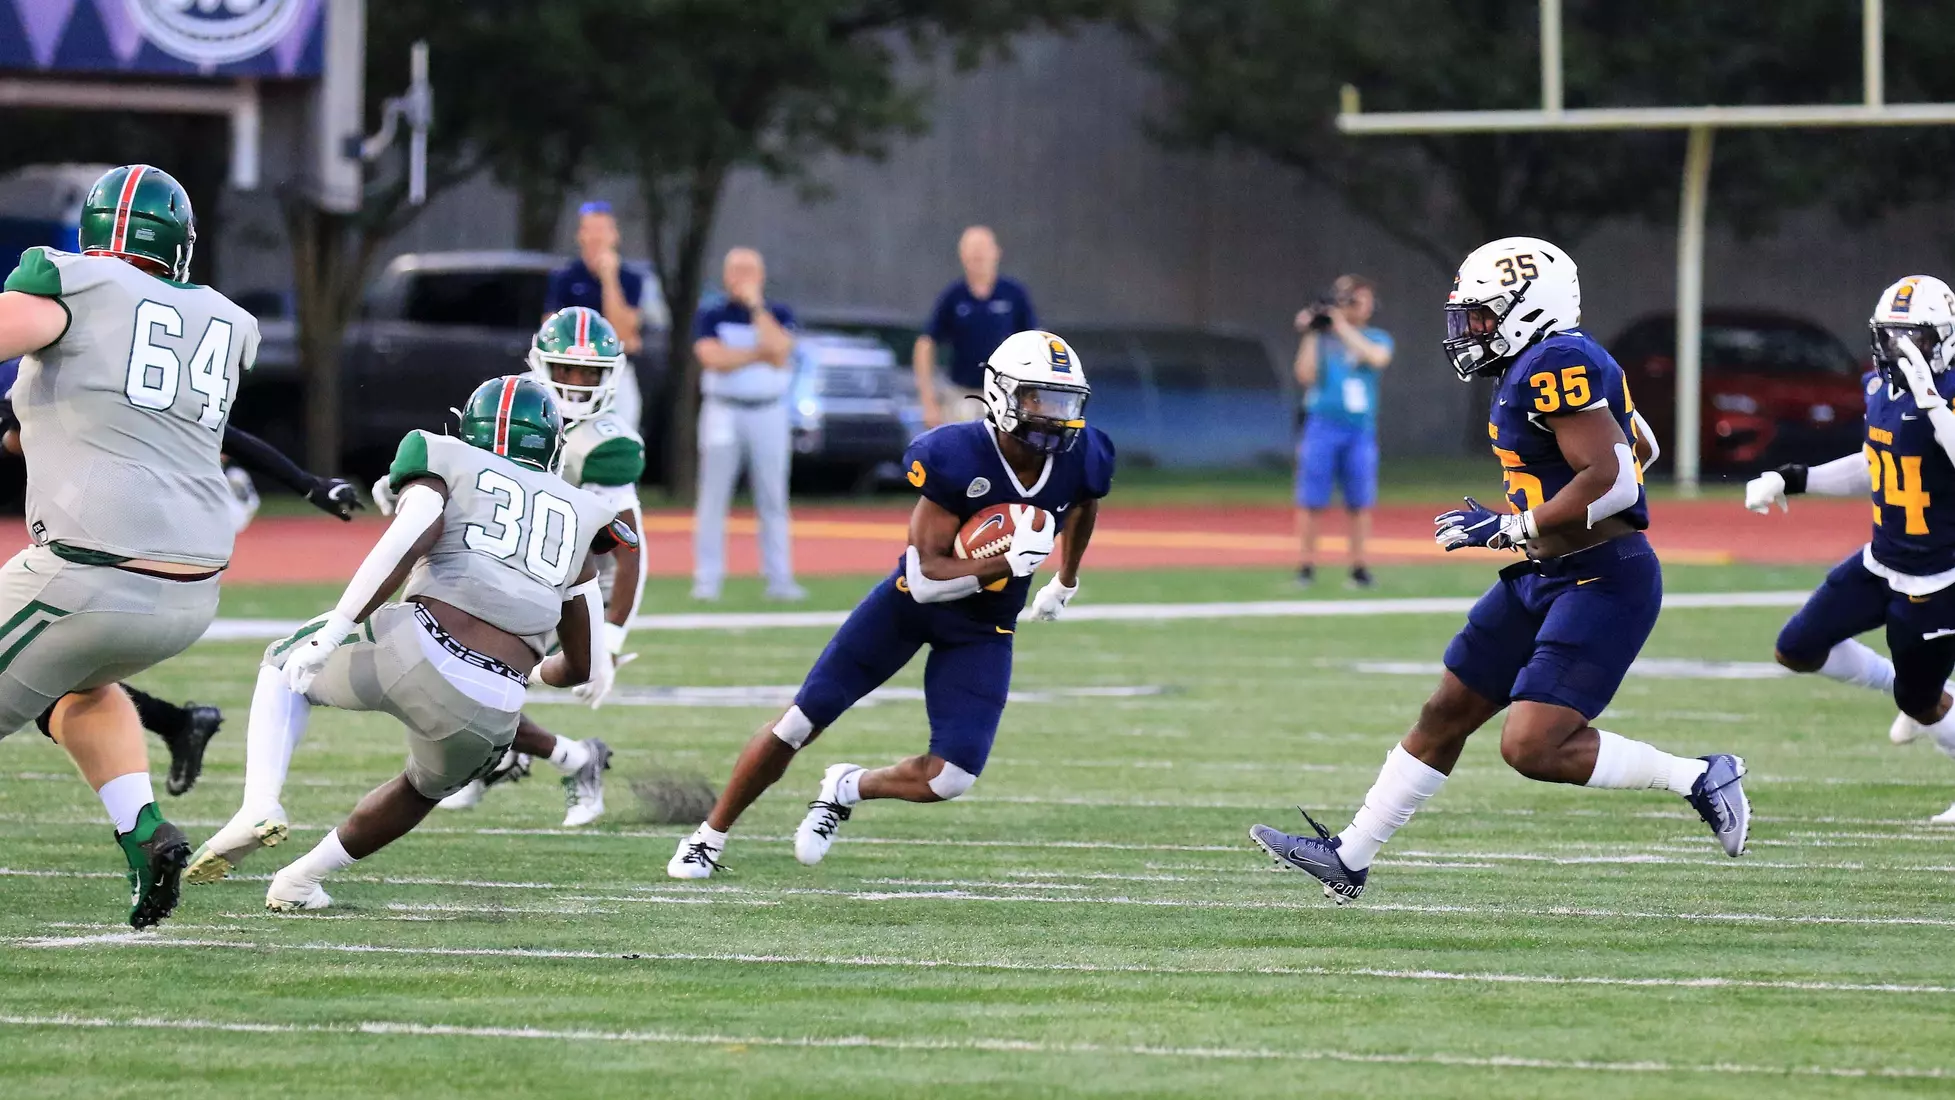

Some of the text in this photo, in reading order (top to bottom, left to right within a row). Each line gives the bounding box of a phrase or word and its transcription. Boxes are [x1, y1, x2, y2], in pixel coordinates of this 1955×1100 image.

[1494, 254, 1539, 287] 35
[124, 298, 233, 432] 64
[1529, 365, 1592, 413] 35
[1864, 441, 1931, 536] 24
[462, 468, 578, 588] 30
[1321, 878, 1364, 897] APOR
